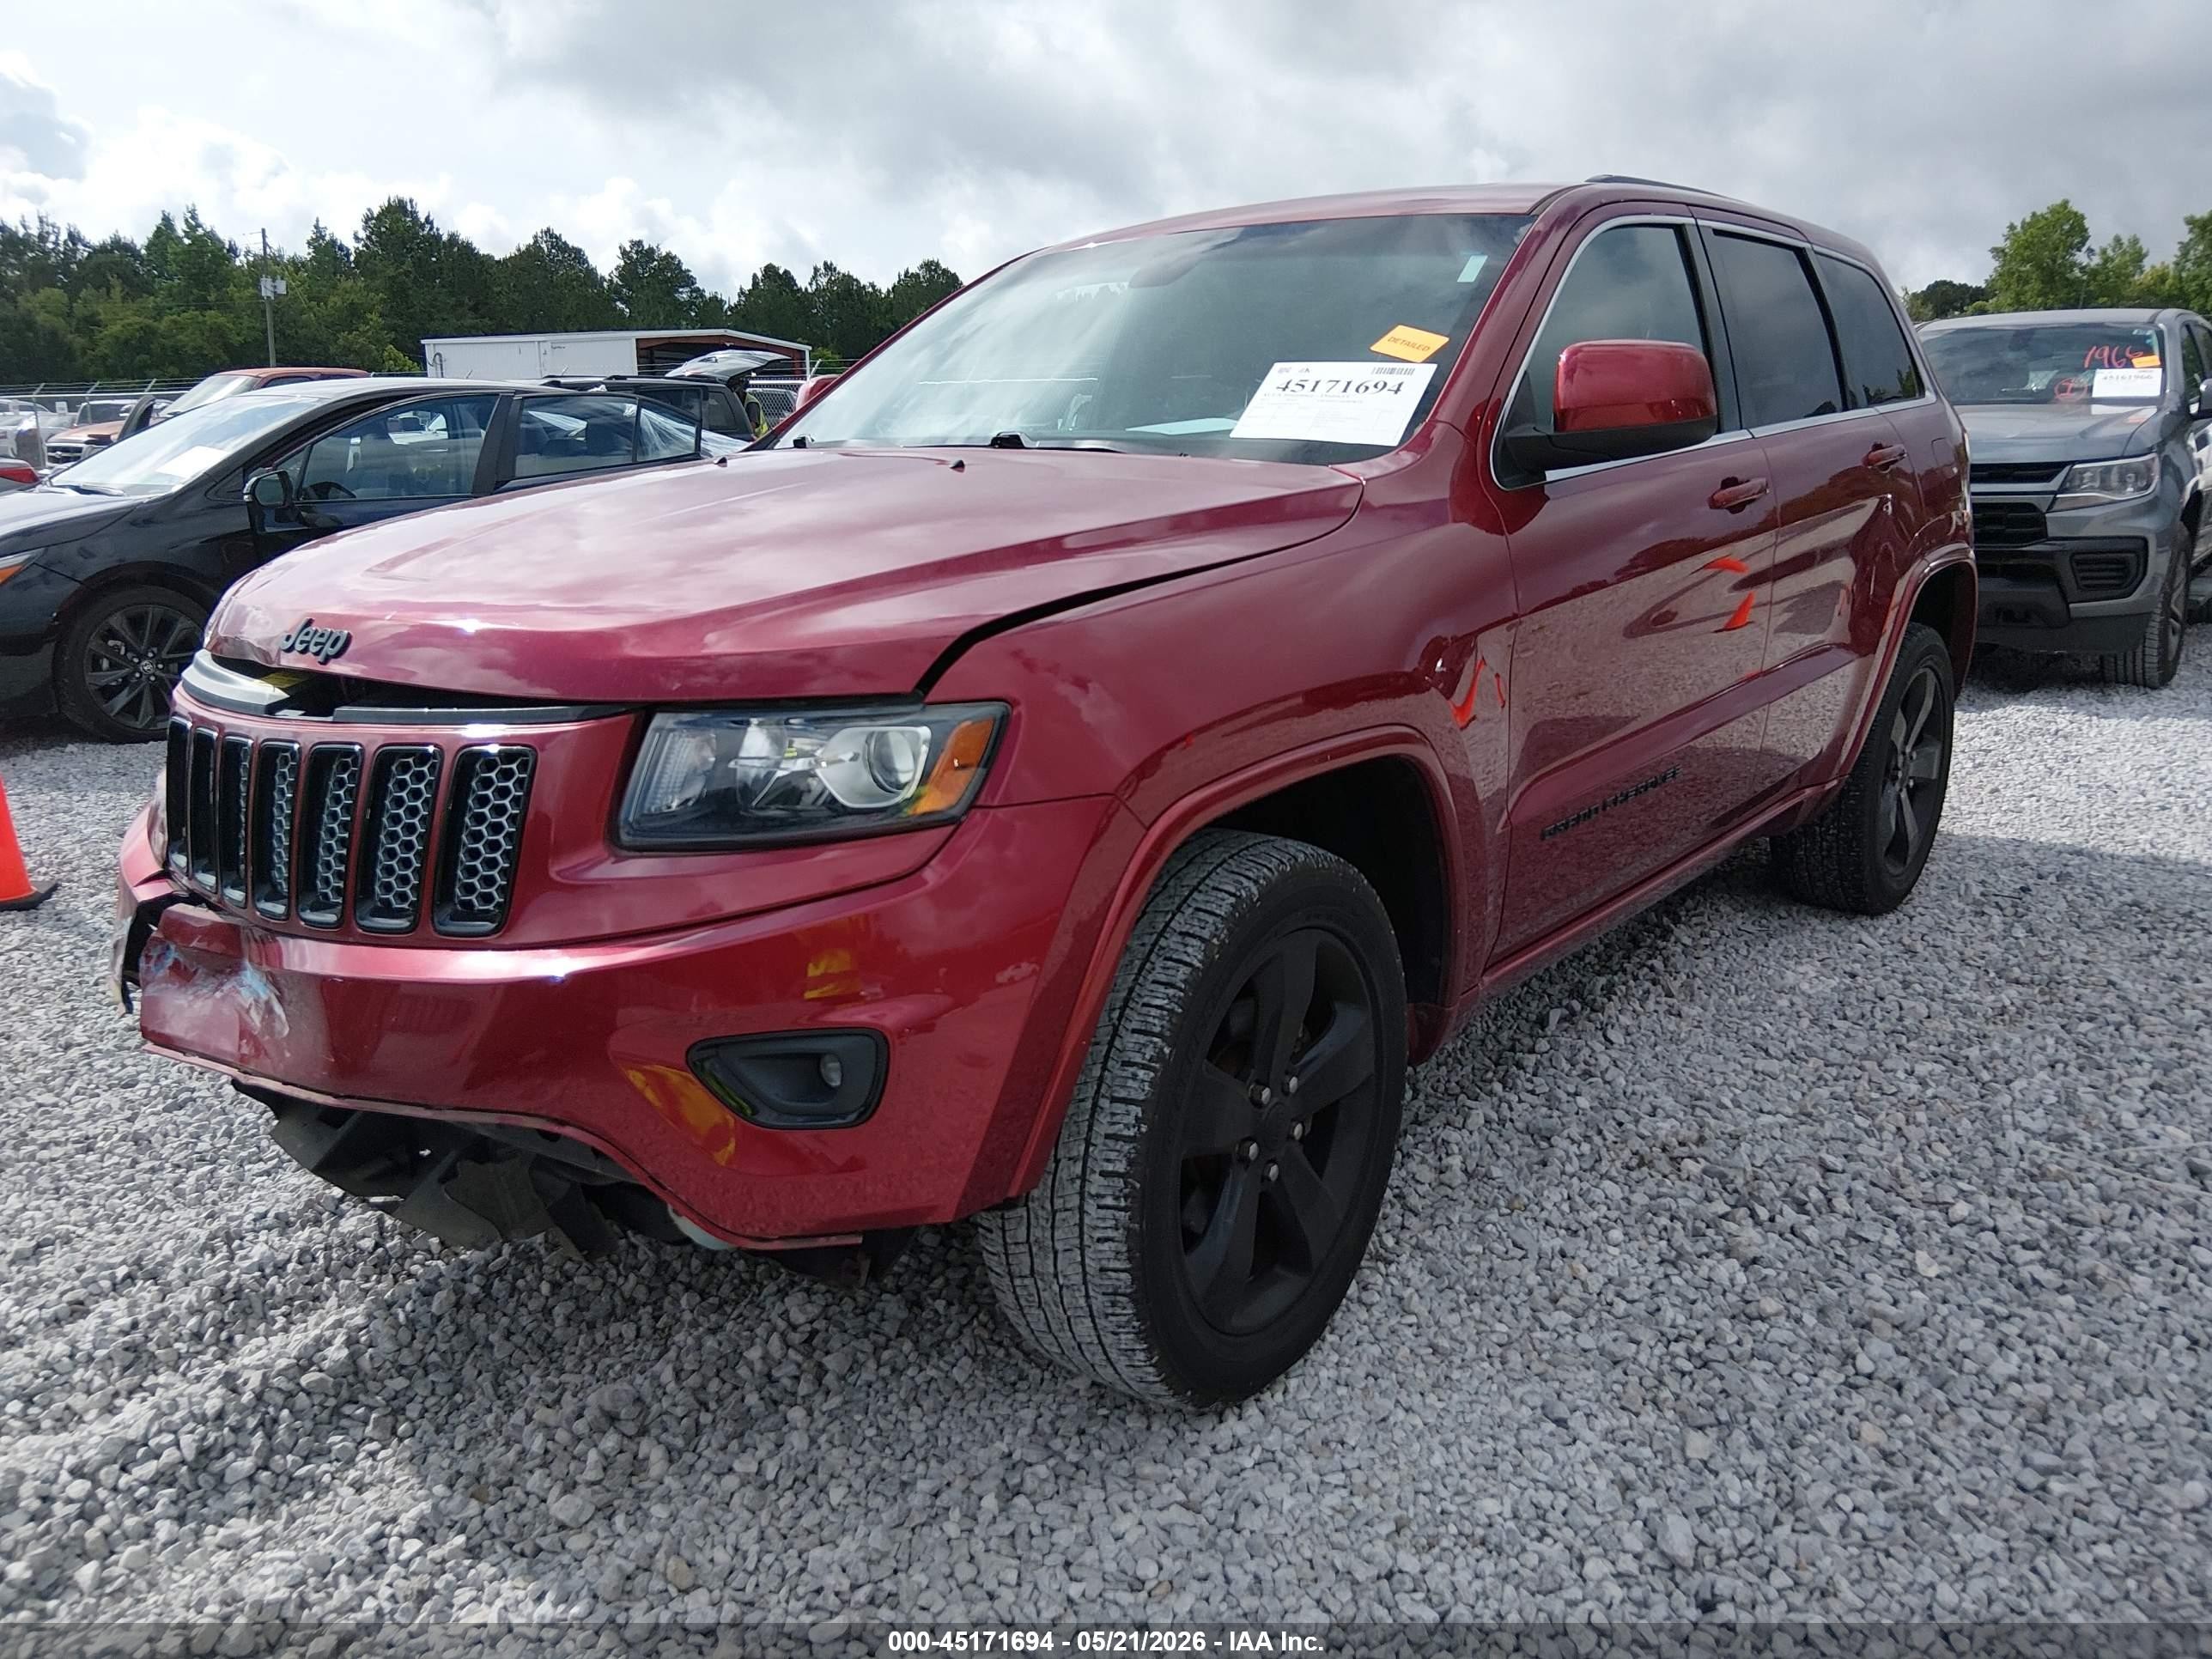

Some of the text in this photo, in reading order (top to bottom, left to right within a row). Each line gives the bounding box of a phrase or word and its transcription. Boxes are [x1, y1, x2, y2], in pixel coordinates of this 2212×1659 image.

[1387, 336, 1431, 352] DETAILED
[1276, 379, 1404, 395] 45171694
[280, 617, 353, 665] Jeep
